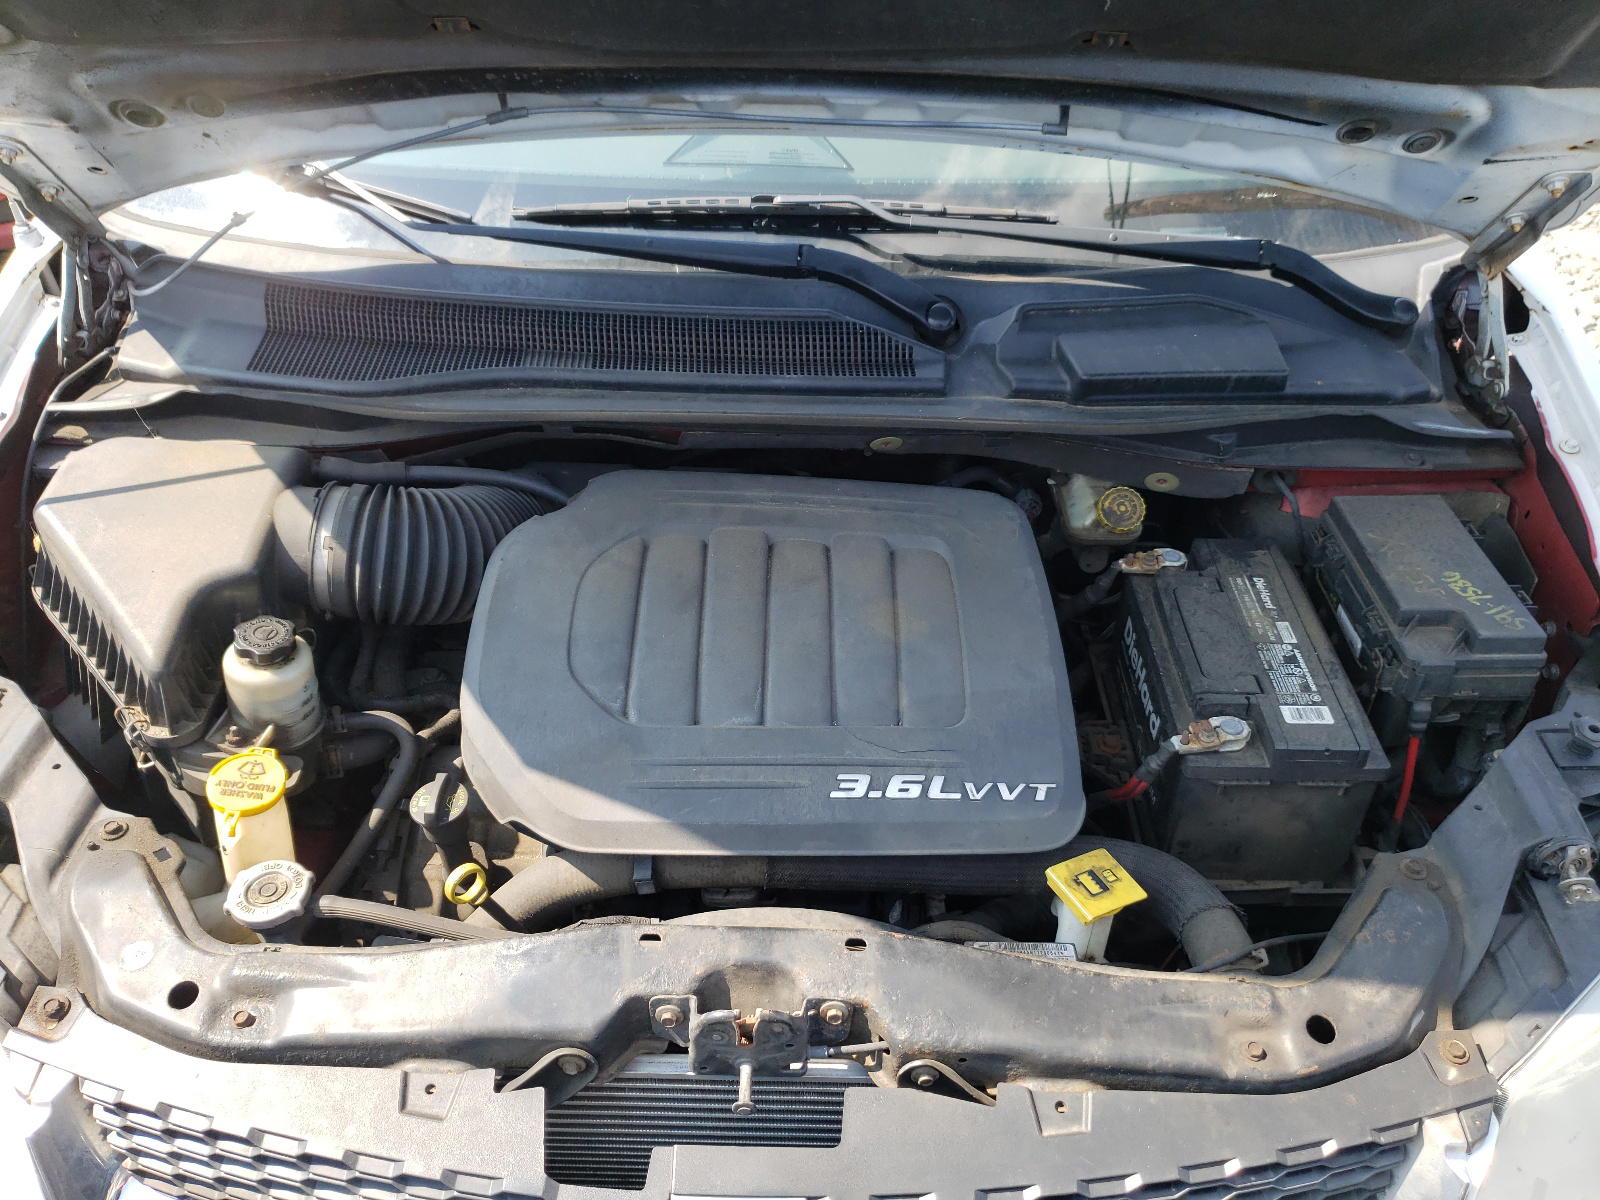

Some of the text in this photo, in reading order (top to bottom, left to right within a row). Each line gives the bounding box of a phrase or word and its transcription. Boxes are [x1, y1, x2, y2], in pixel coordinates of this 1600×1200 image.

[1253, 577, 1277, 610] DieHard
[1124, 616, 1160, 740] DieHard
[214, 780, 277, 793] FLUID ONLY
[219, 788, 264, 800] WASHER
[829, 773, 1057, 801] 3.6L VVT
